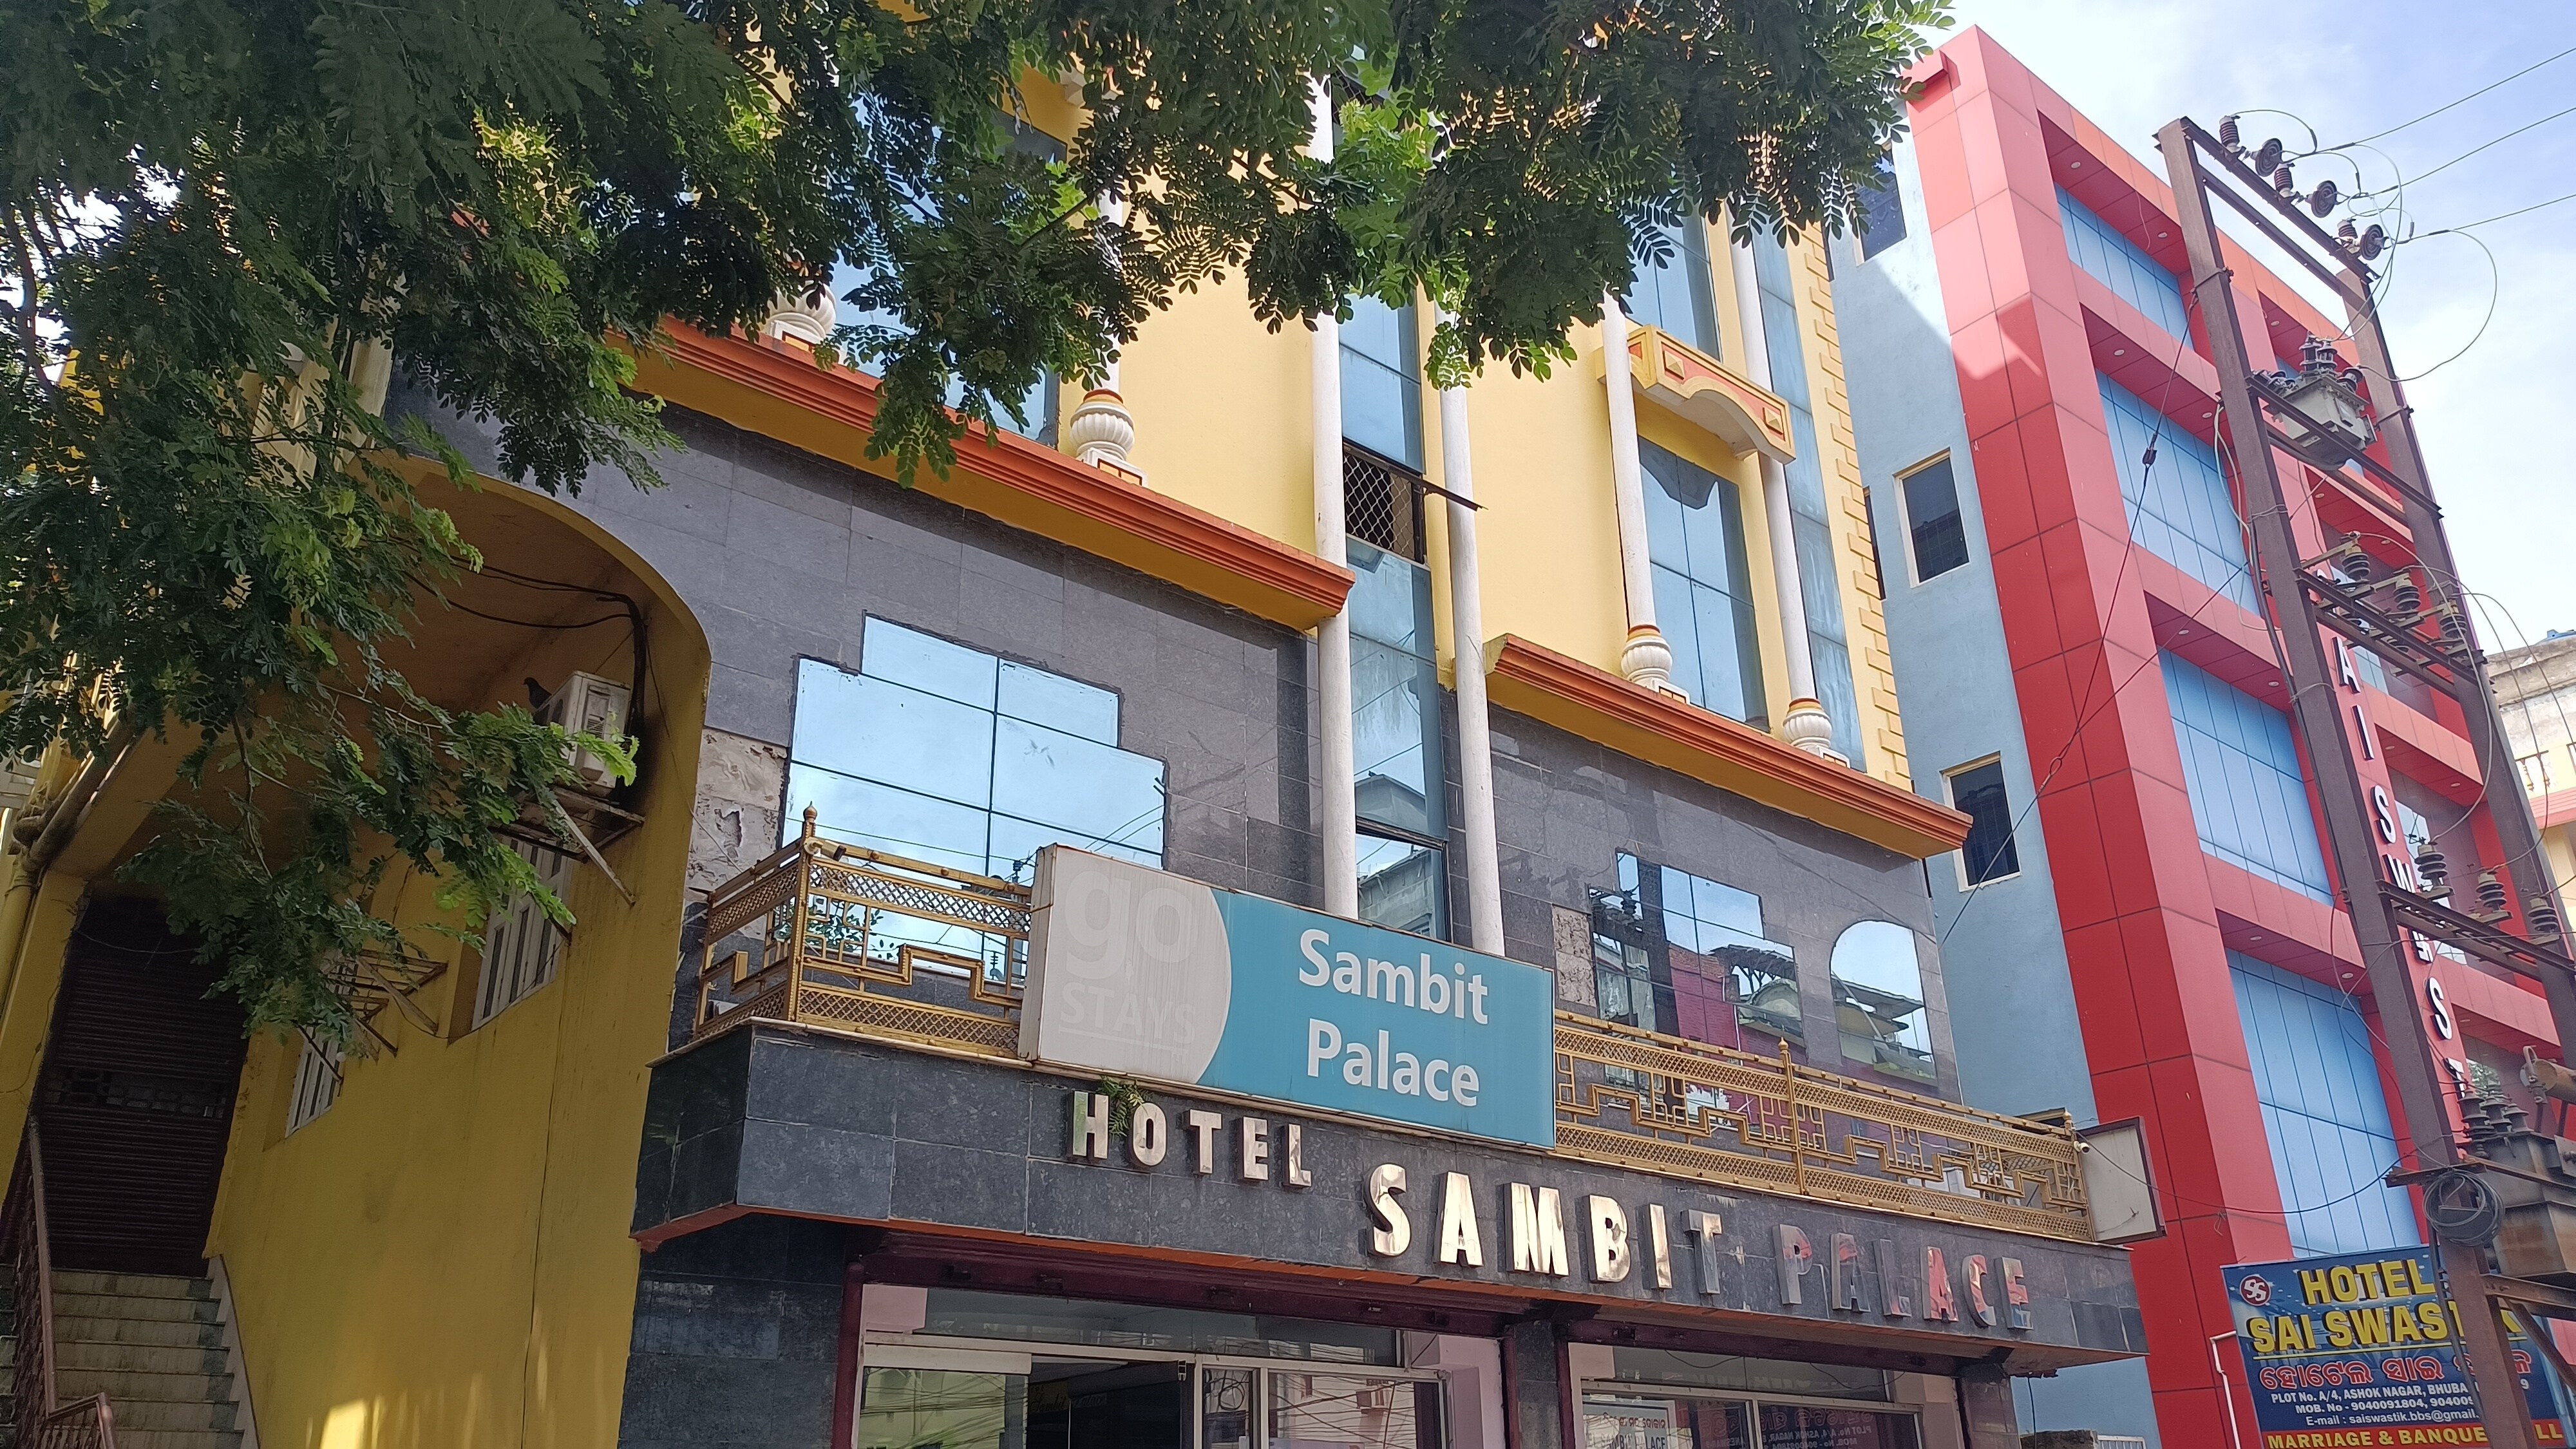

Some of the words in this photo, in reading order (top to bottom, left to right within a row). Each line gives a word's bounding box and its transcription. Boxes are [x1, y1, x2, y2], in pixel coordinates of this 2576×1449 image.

[1065, 871, 1198, 980] go
[1300, 929, 1489, 1025] Sambit
[1061, 981, 1196, 1045] STAYS
[1307, 1018, 1480, 1106] Palace
[1069, 1090, 1312, 1188] HOTEL
[1367, 1163, 1722, 1295] SAMBIT
[1773, 1224, 2034, 1330] PALACE
[2299, 1259, 2436, 1305] HOTEL
[2248, 1309, 2315, 1352] SAI
[2271, 1392, 2297, 1403] PLOT
[2298, 1391, 2316, 1402] No.
[2319, 1390, 2342, 1402] A/4,
[2344, 1387, 2382, 1399] ASHOK
[2383, 1385, 2426, 1397] NAGAR,
[2295, 1404, 2325, 1414] MOB.
[2327, 1403, 2342, 1412] No
[2351, 1399, 2428, 1412] 9040091804,
[2306, 1415, 2340, 1425] E-mail
[2349, 1409, 2479, 1425] saiswastik.bbs@gmail.
[2268, 1432, 2373, 1449] MARRIAGE
[2379, 1430, 2394, 1445] &
[2398, 1426, 2488, 1445] BANQUE
